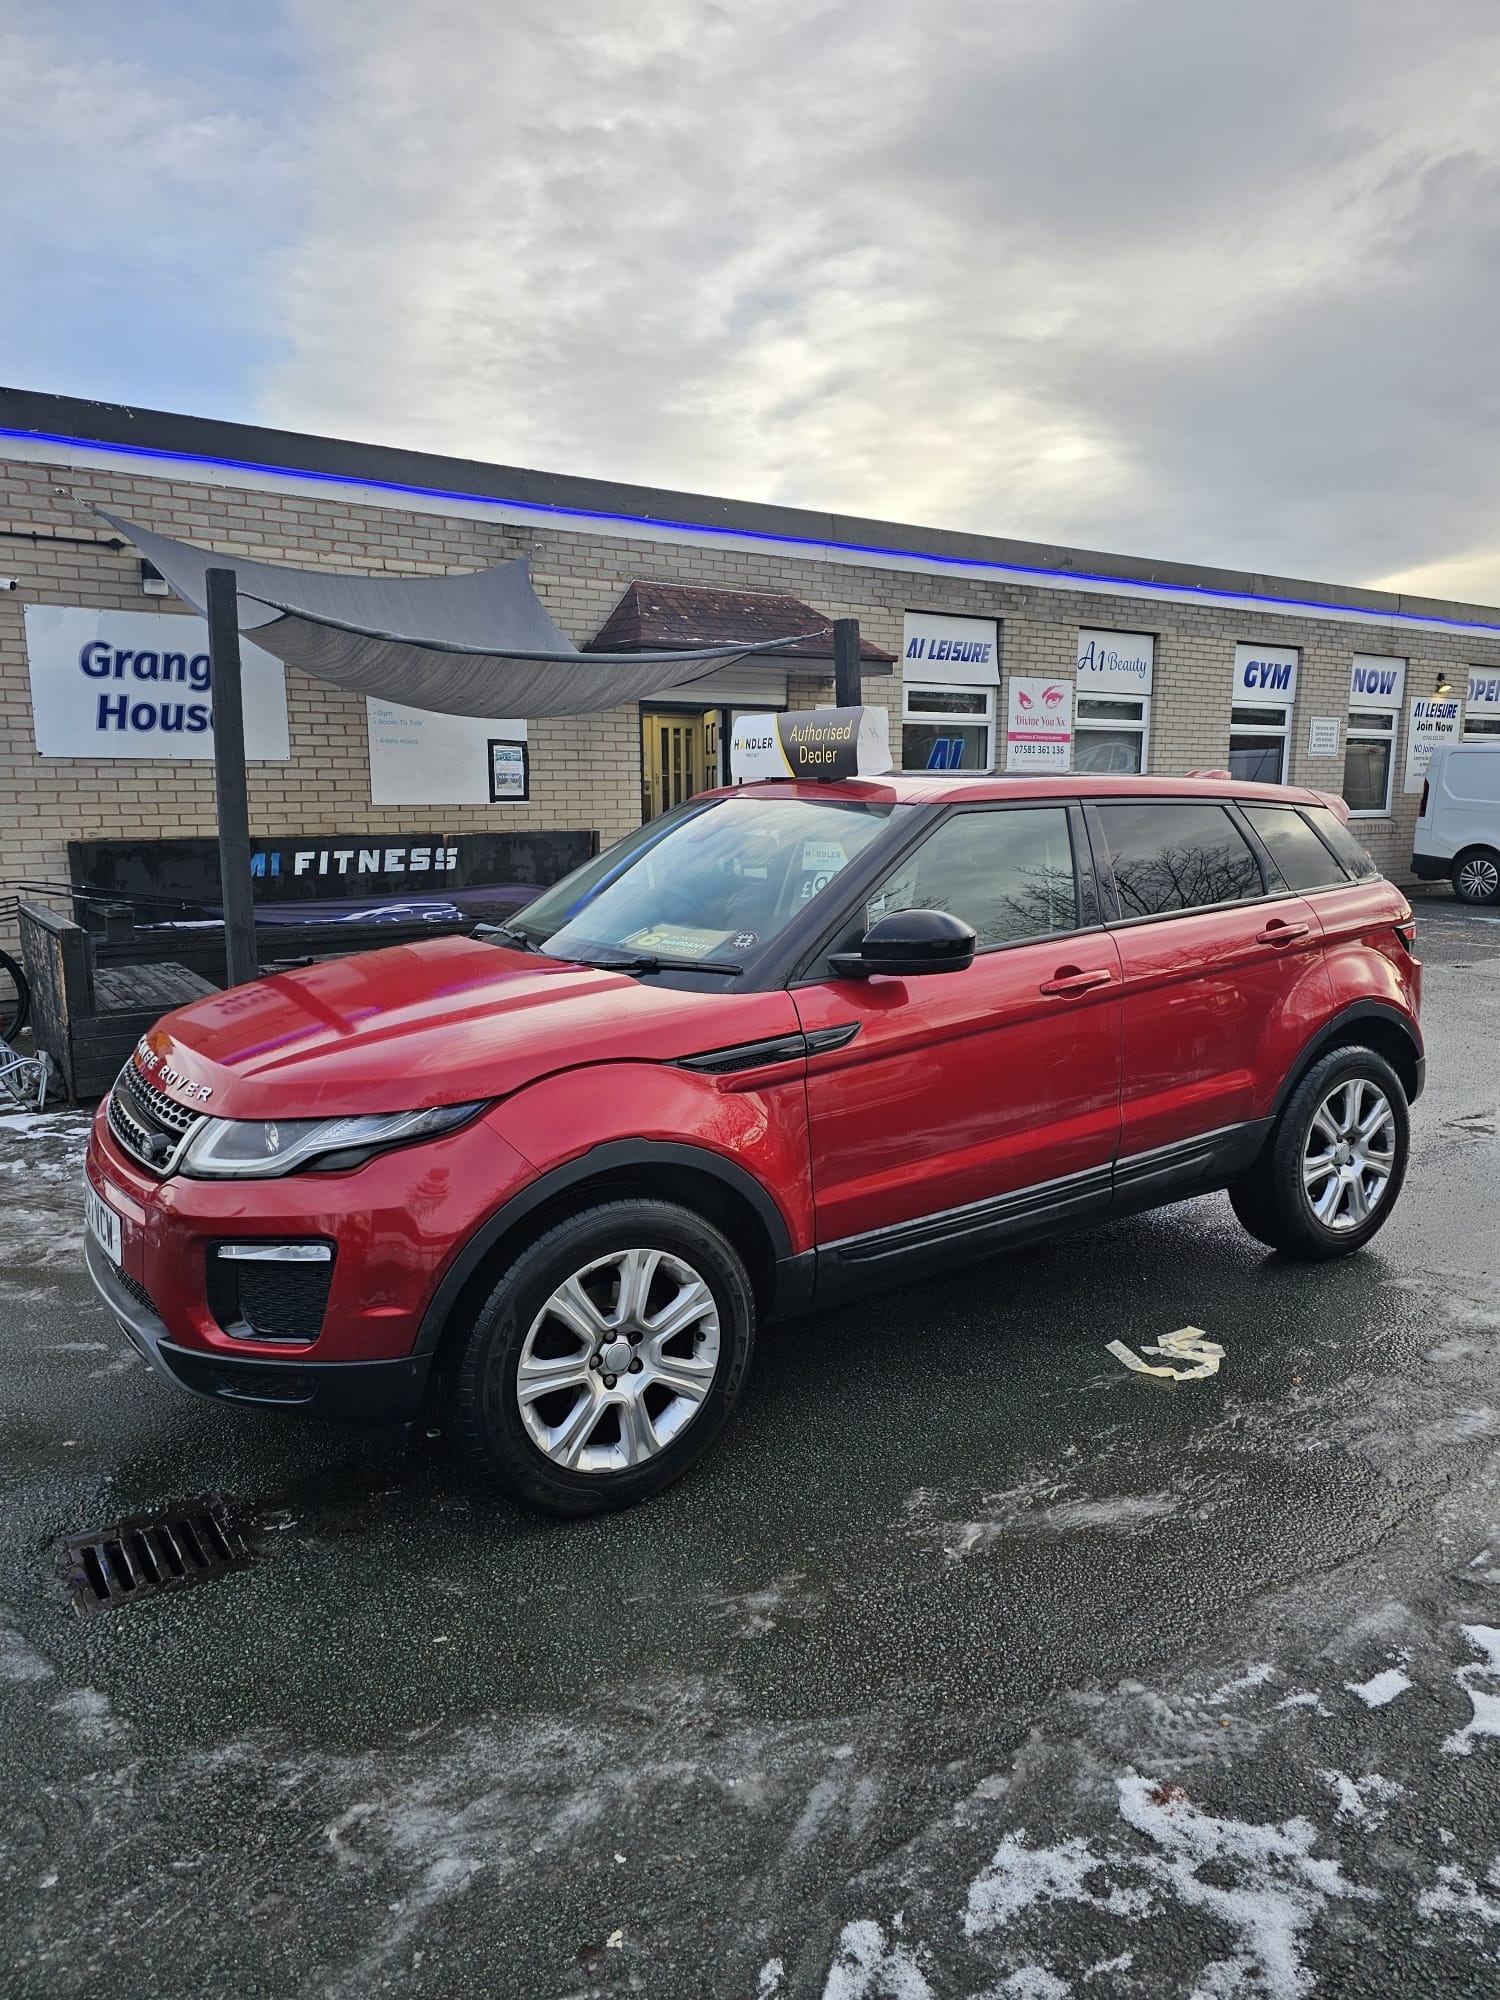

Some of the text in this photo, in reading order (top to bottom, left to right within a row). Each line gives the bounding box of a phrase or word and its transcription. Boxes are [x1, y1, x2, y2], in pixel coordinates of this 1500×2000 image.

[928, 639, 992, 664] LEISURE
[1078, 641, 1147, 679] A1 Beauty
[80, 640, 213, 692] Grang
[1243, 661, 1292, 690] GYM
[1352, 668, 1398, 695] NOW
[97, 694, 215, 732] Hous
[1425, 703, 1459, 719] LEISURE
[790, 719, 853, 742] Authorised
[1416, 720, 1454, 733] Join Now
[734, 737, 773, 750] HANDLER
[799, 744, 837, 764] Dealer
[1014, 745, 1036, 754] 07581
[1037, 745, 1050, 754] 361
[294, 847, 458, 876] FITNESS
[158, 1065, 213, 1103] ROVER
